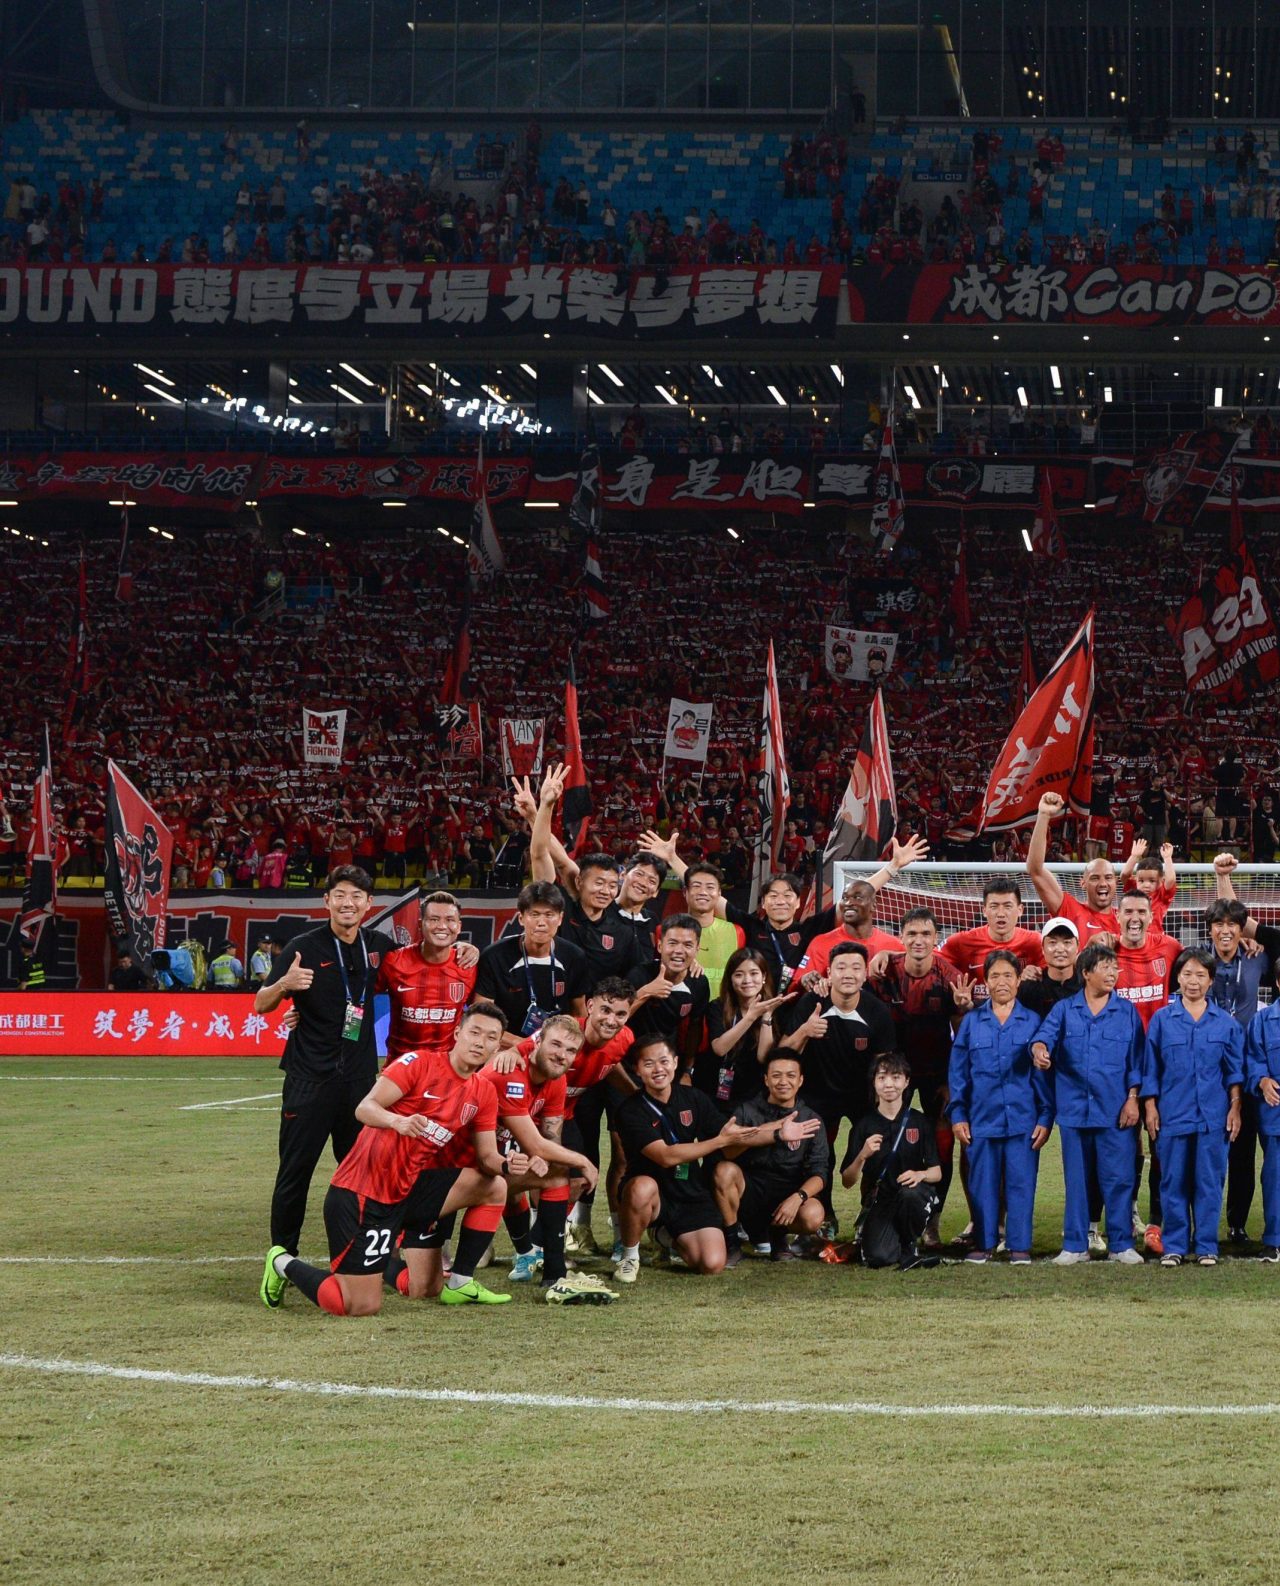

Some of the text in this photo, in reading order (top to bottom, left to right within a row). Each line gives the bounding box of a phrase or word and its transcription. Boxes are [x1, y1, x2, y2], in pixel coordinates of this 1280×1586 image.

[949, 264, 1069, 321] 成都
[306, 745, 340, 757] FIGHTING
[1116, 984, 1164, 999] 成都蓉城
[0, 1014, 65, 1027] 成都建工
[401, 1007, 457, 1020] 成都蓉城
[365, 1228, 392, 1256] 22
